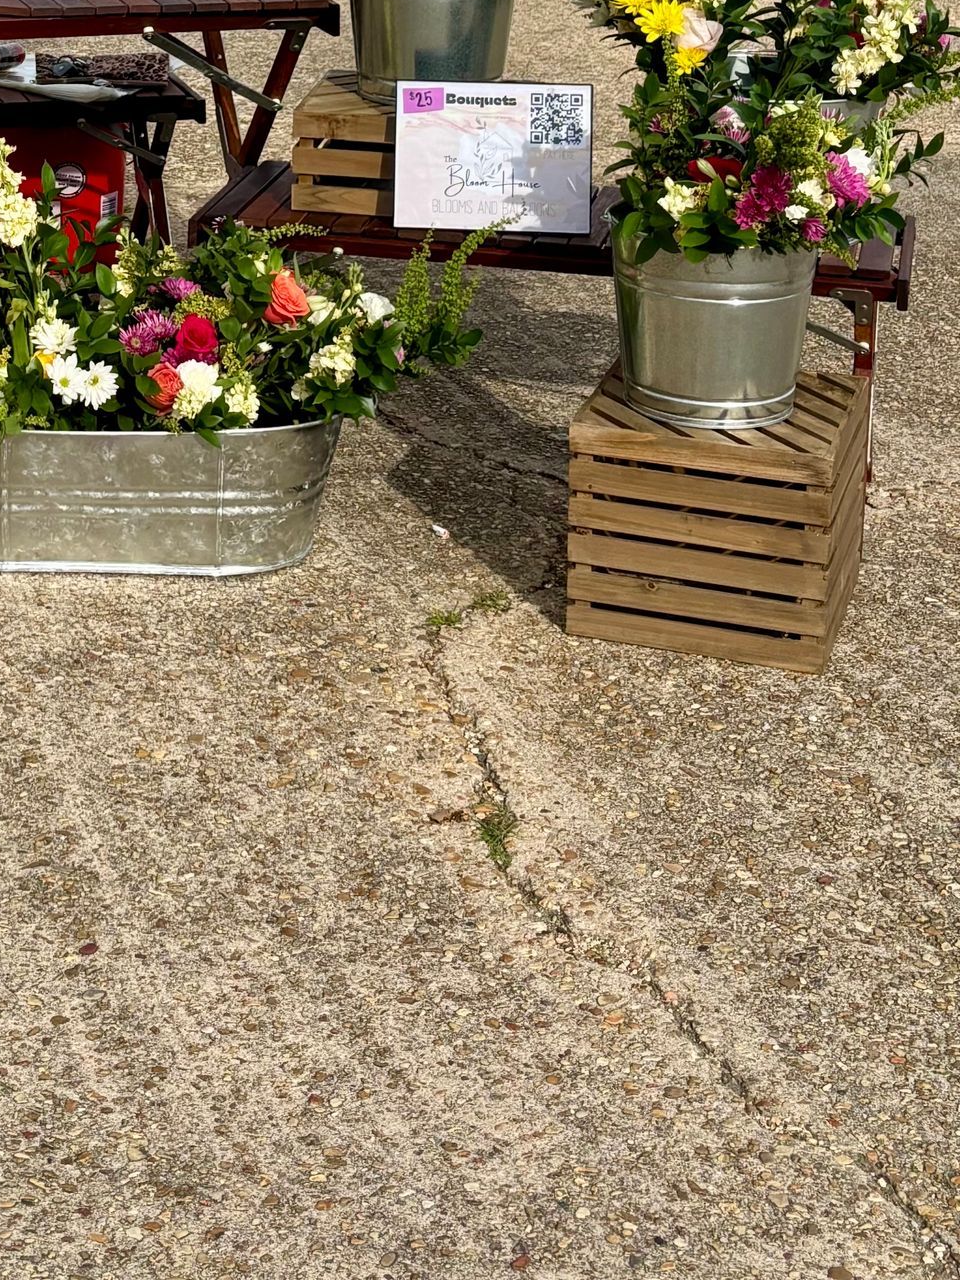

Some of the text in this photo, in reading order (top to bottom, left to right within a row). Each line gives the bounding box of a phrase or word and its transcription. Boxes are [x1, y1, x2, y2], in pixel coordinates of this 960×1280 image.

[409, 91, 517, 108] $25 Bouquets
[443, 155, 458, 163] The
[443, 163, 542, 199] Bloom House
[431, 198, 473, 214] BLOOMS
[477, 199, 498, 216] AND
